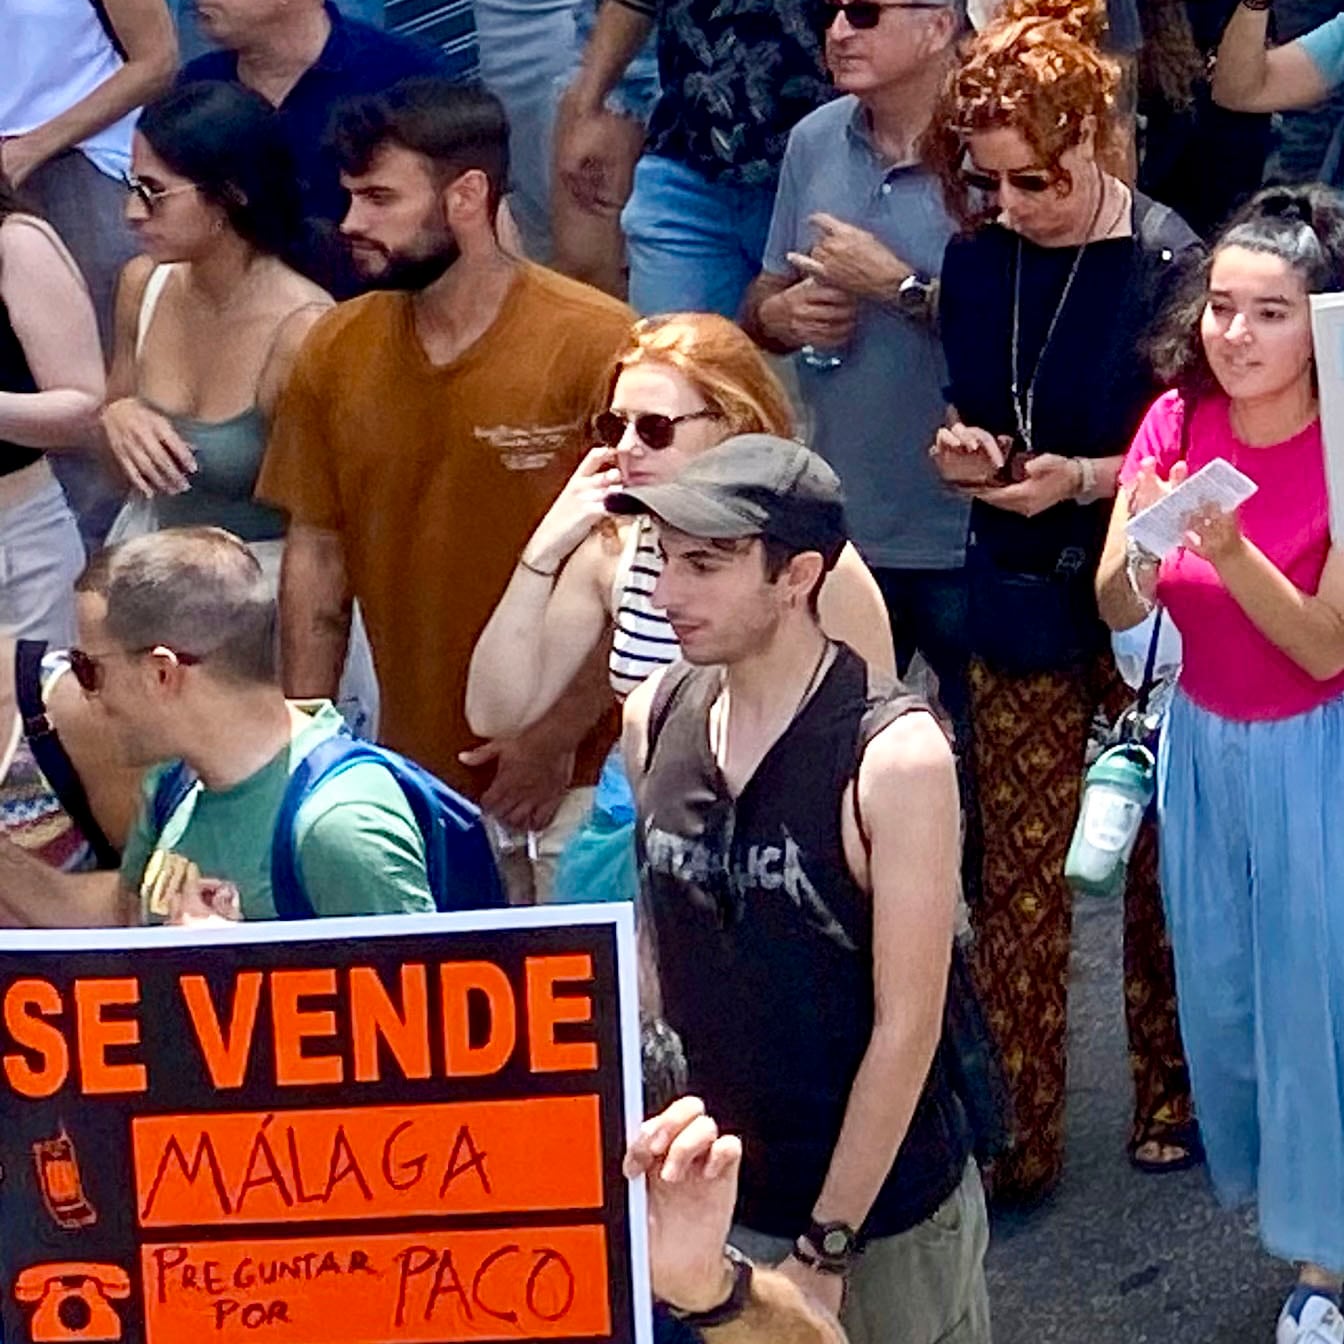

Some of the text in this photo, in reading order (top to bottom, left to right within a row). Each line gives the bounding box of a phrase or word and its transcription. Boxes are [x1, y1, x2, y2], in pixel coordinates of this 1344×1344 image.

[3, 953, 599, 1099] SE VENDE
[141, 1113, 493, 1221] MÁLAGA
[153, 1244, 576, 1329] PREGUNTAR PACO
[213, 1298, 292, 1331] POR
